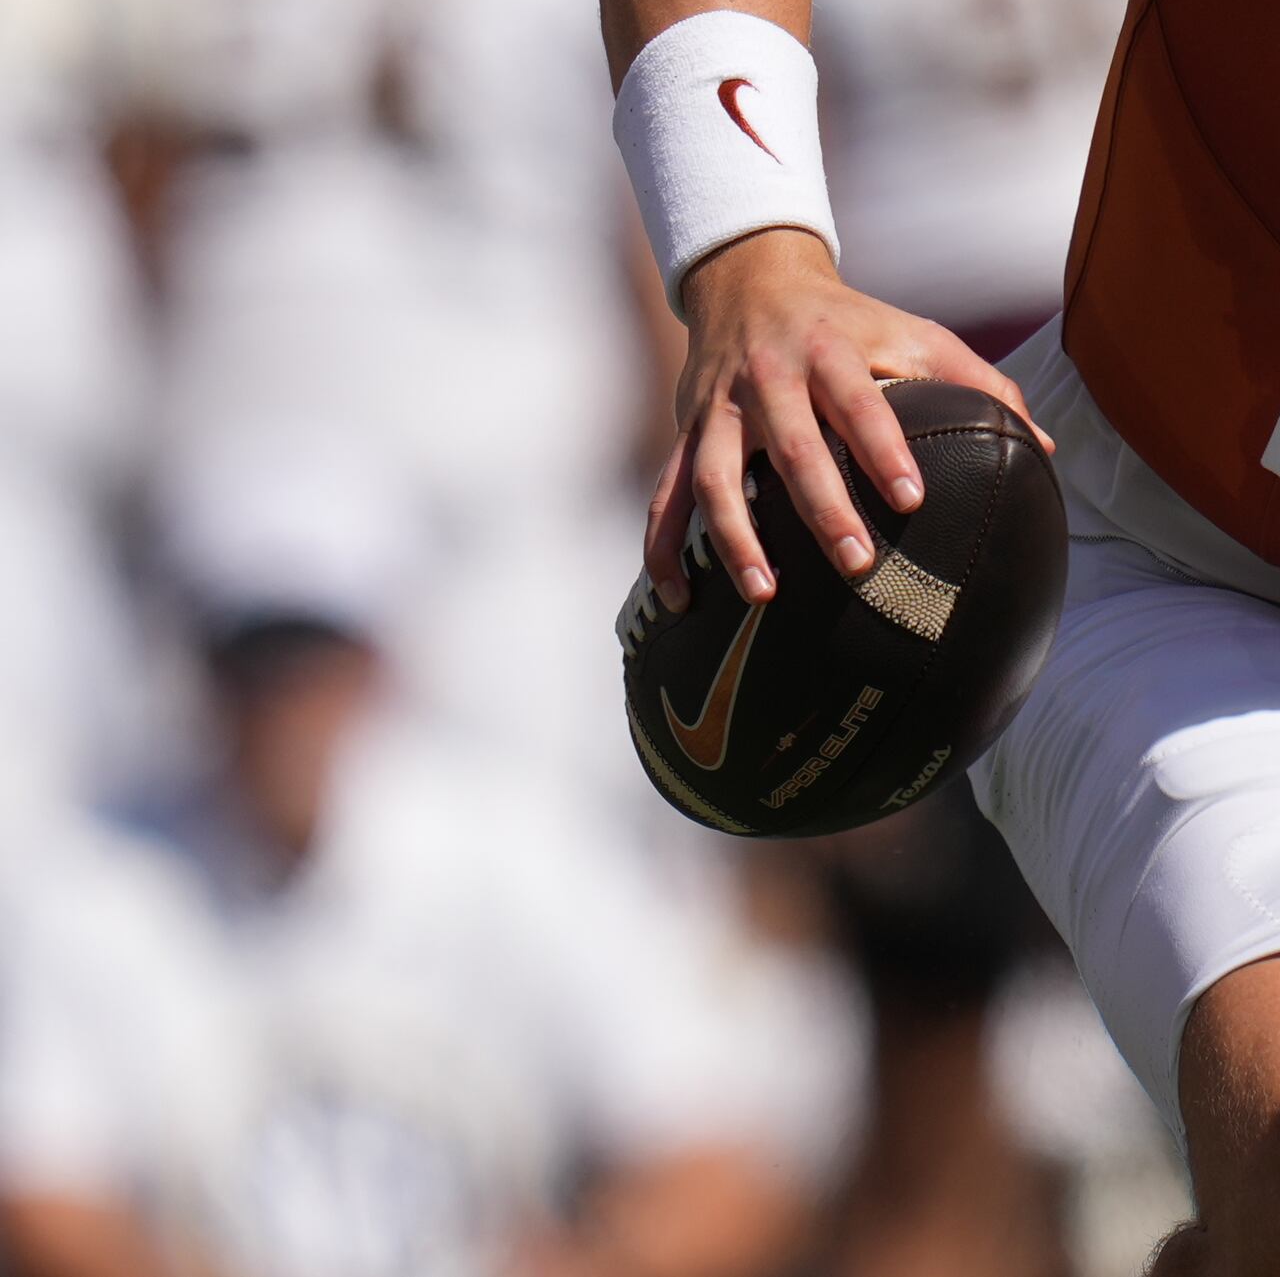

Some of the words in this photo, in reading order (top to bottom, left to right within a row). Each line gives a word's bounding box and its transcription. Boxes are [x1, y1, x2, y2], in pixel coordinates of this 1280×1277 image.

[759, 755, 832, 810] VAPOR
[818, 684, 885, 760] ELITE
[879, 744, 952, 810] Texas
